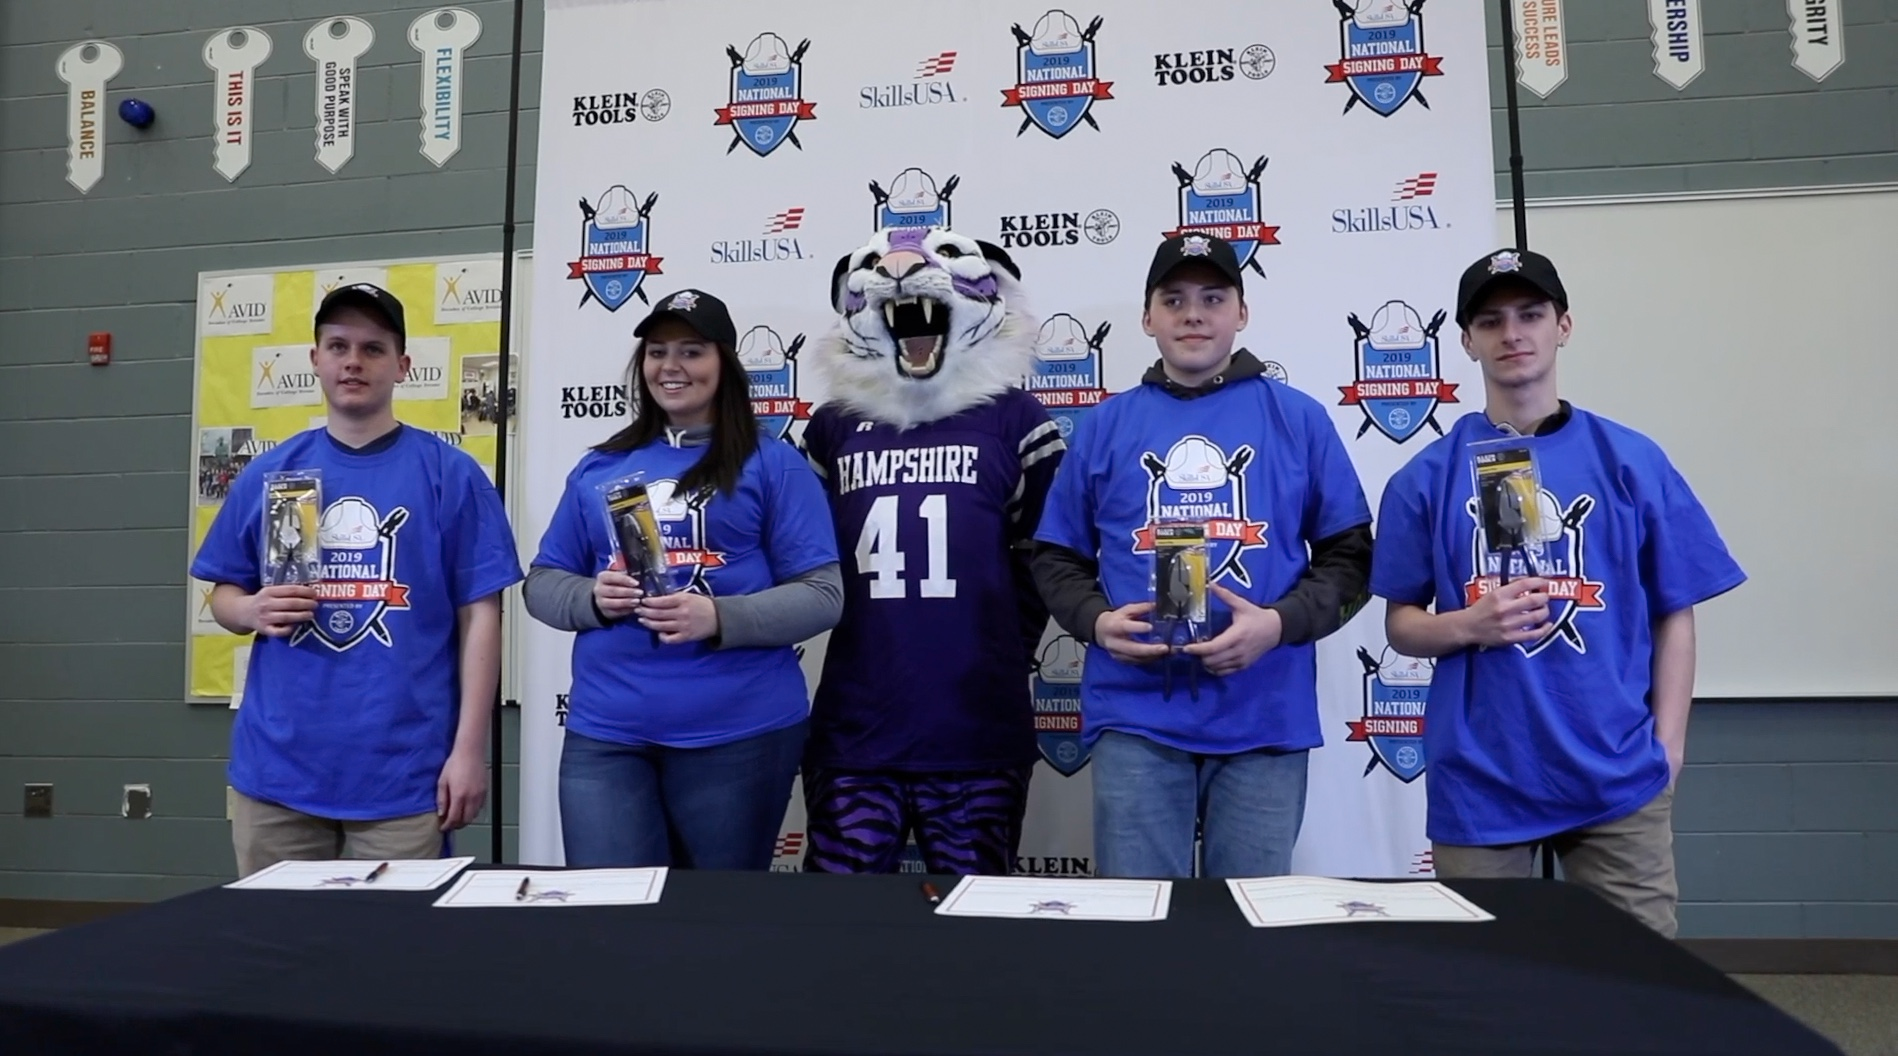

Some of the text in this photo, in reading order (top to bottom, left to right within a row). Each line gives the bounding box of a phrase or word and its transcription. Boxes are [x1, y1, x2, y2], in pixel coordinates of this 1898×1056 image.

[1368, 30, 1396, 40] 2019
[1523, 1, 1541, 59] SUCCESS
[1351, 40, 1414, 56] NATIONAL
[1543, 26, 1560, 66] LEADS
[1043, 56, 1070, 66] 2019
[1155, 48, 1234, 70] KLEIN
[1343, 57, 1424, 74] SIGNING DAY
[1027, 66, 1086, 81] NATIONAL
[1155, 65, 1235, 86] TOOLS
[753, 77, 778, 87] 2019
[1018, 81, 1095, 98] SIGNING DAY
[434, 48, 452, 141] FLEXIBILITY
[573, 92, 637, 111] KLEIN
[739, 87, 792, 102] NATIONAL
[859, 81, 957, 109] SkillsUSA
[227, 70, 243, 145] THIS IS IT
[323, 61, 336, 147] GOOD PURPOSE
[338, 68, 351, 138] SPEAK WITH
[730, 101, 800, 118] SIGNING DAY
[573, 108, 636, 126] TOOLS
[80, 90, 95, 160] BALANCE
[1206, 198, 1234, 208] 2019
[900, 215, 925, 225] 2019
[1000, 213, 1079, 232] KLEIN
[1189, 208, 1251, 224] NATIONAL
[1332, 205, 1440, 233] SkillsUSA
[604, 231, 627, 241] 2019
[1000, 229, 1079, 248] TOOLS
[1237, 225, 1261, 238] DAY
[589, 241, 640, 255] NATIONAL
[710, 238, 805, 264] SkillsUSA
[581, 256, 648, 271] SIGNING DAY
[462, 289, 503, 305] AVID
[229, 303, 266, 318] AVID
[1383, 353, 1411, 363] 2019
[1048, 363, 1076, 373] 2019
[1366, 364, 1430, 379] NATIONAL
[277, 373, 315, 389] AVID
[1031, 374, 1093, 389] NATIONAL
[562, 385, 627, 402] KLEIN
[1357, 381, 1440, 397] SIGNING DAY
[1078, 391, 1102, 404] DAY
[561, 401, 627, 418] TOOLS
[774, 401, 796, 413] DAY
[837, 445, 979, 495] HAMPSHIRE
[1180, 492, 1213, 503] 2019
[1161, 503, 1232, 518] NATIONAL
[1216, 522, 1242, 537] DAY
[854, 494, 957, 599] 41
[331, 552, 363, 563] 2019
[675, 552, 702, 564] DAY
[362, 584, 388, 598] DAY
[1548, 581, 1577, 596] DAY
[1392, 690, 1420, 700] 2019
[1036, 699, 1081, 712] NATION
[1374, 702, 1426, 716] NATION
[1034, 716, 1078, 729] IGNING
[1365, 720, 1418, 733] SIGNING
